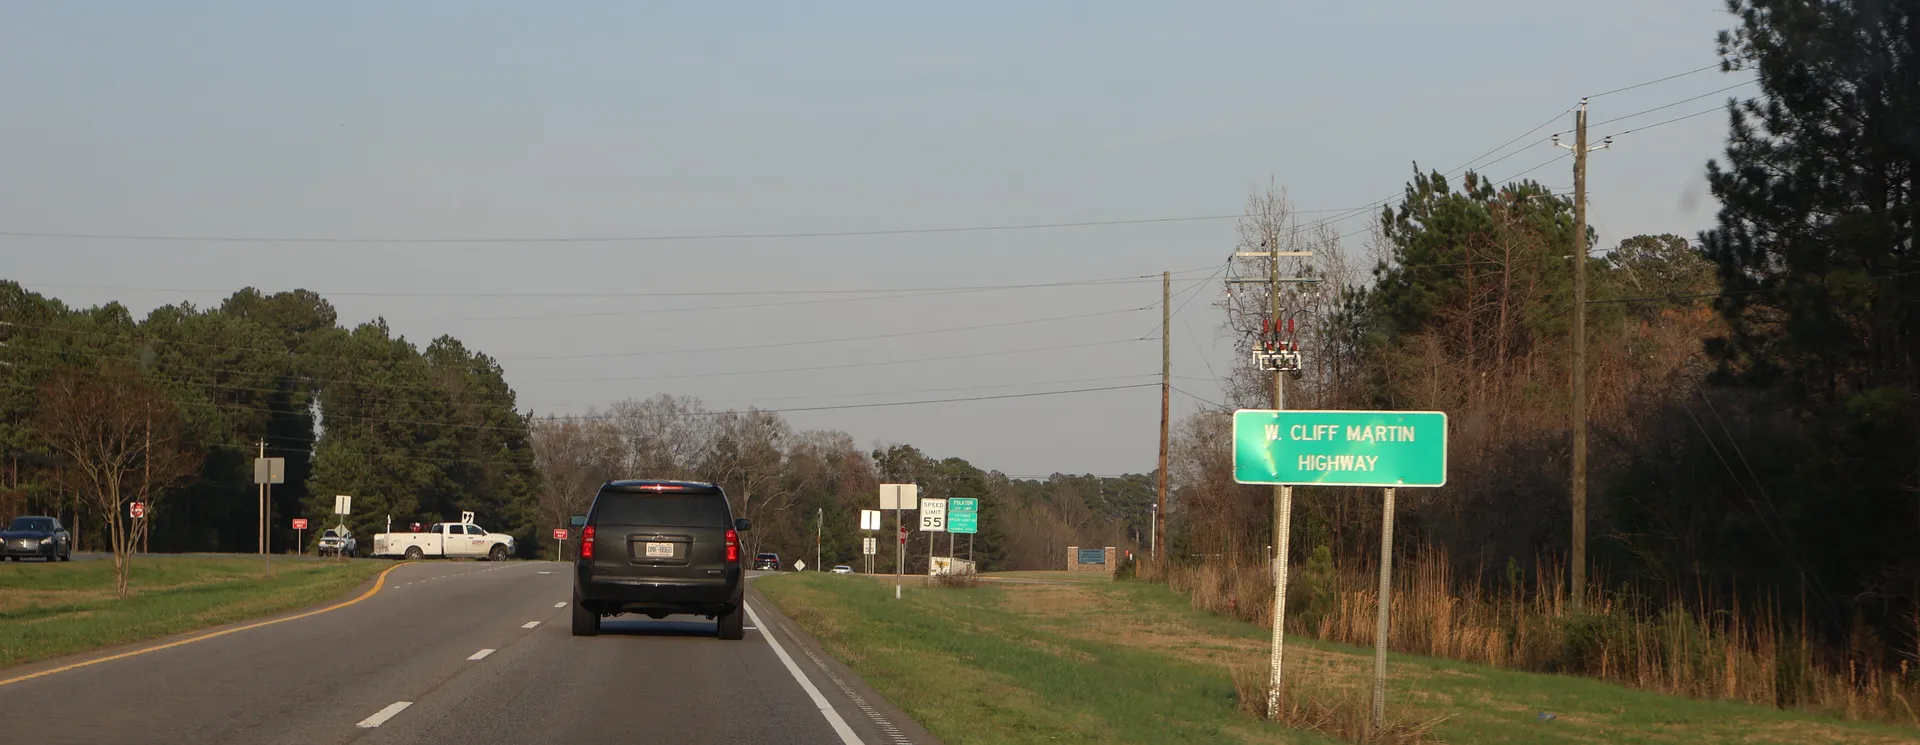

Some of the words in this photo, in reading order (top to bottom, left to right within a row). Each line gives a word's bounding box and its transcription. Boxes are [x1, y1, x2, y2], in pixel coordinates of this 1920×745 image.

[1264, 424, 1282, 441] W.
[1290, 424, 1339, 441] CLIFF
[1346, 425, 1415, 442] MARTIN
[1298, 455, 1379, 472] HIGHWAY
[923, 517, 942, 527] 55
